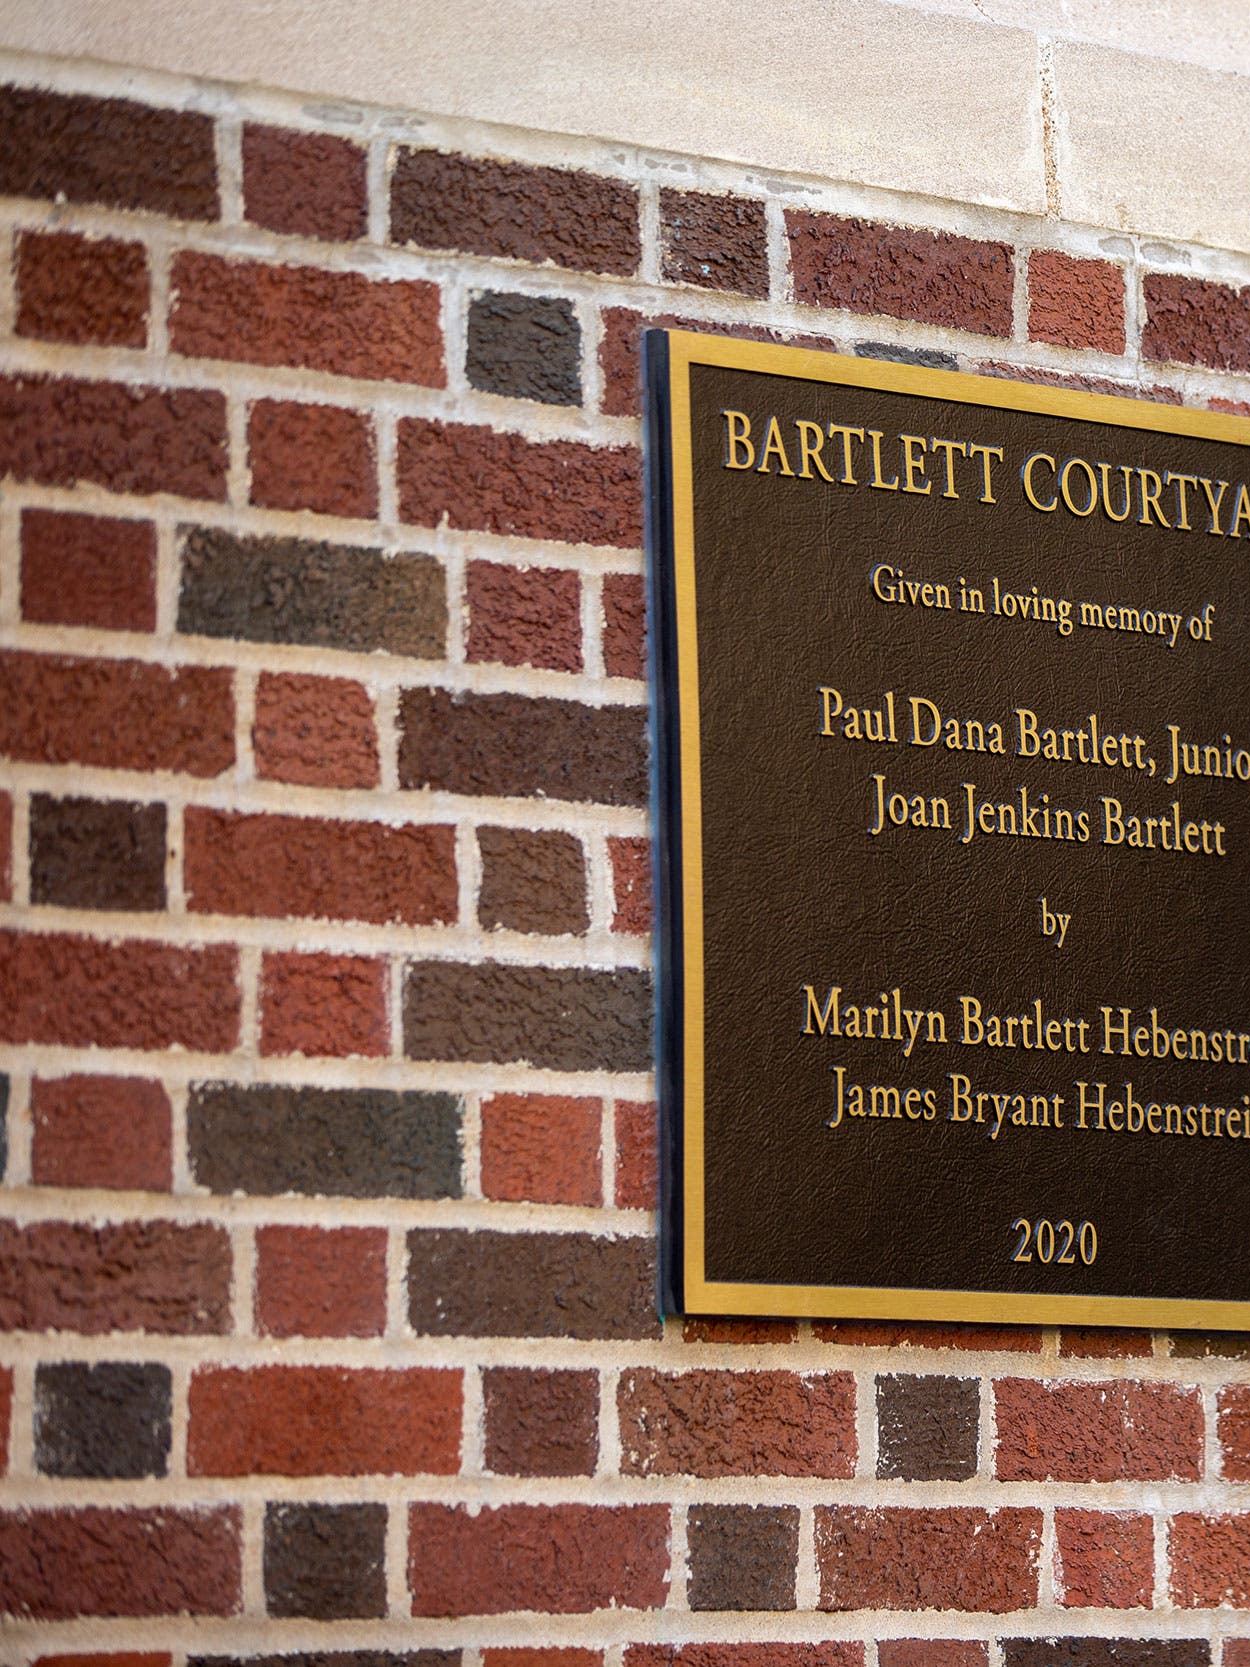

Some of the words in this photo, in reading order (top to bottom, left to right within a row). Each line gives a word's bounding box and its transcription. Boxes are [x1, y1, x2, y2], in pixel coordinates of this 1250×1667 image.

[723, 410, 1004, 504] BARTLETT
[873, 565, 952, 609] Given
[959, 577, 986, 613] in
[992, 577, 1074, 636] loving
[1081, 603, 1183, 648] memory
[1189, 604, 1216, 641] of
[819, 687, 899, 743] Paul
[908, 696, 1007, 755] Dana
[1016, 709, 1156, 777] Bartlett,
[871, 774, 953, 835] Joan
[962, 783, 1090, 844] Jenkins
[1102, 797, 1226, 856] Bartlett
[1041, 897, 1072, 949] by
[803, 985, 948, 1057] Marilyn
[959, 996, 1090, 1053] Bartlett
[829, 1067, 937, 1128] James
[950, 1074, 1065, 1140] Bryant
[1014, 1218, 1098, 1265] 2020
